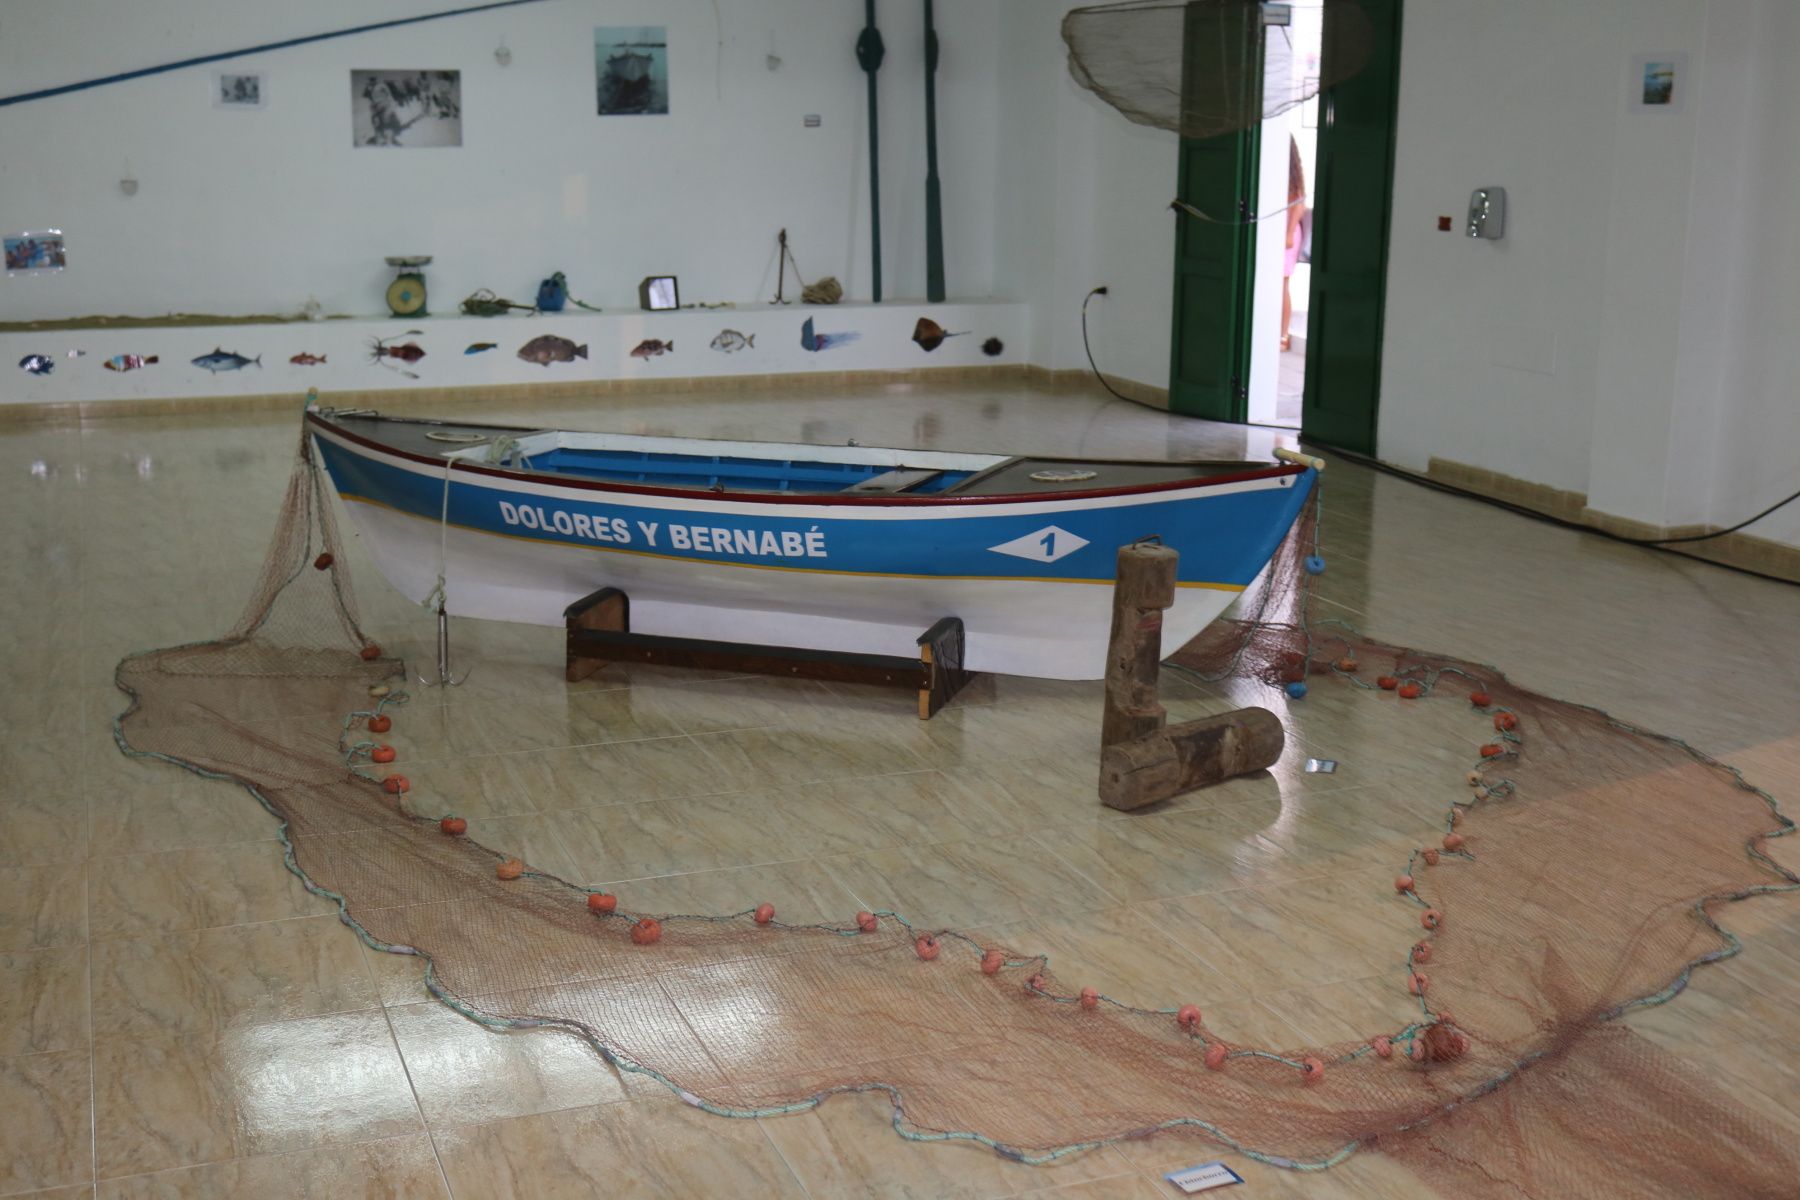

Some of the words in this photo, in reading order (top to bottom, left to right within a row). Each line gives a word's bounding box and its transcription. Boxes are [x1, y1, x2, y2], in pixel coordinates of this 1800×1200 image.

[499, 501, 632, 543] DOLORES
[637, 521, 658, 546] Y
[669, 524, 827, 557] BERNABÉ
[1039, 532, 1055, 556] 1
